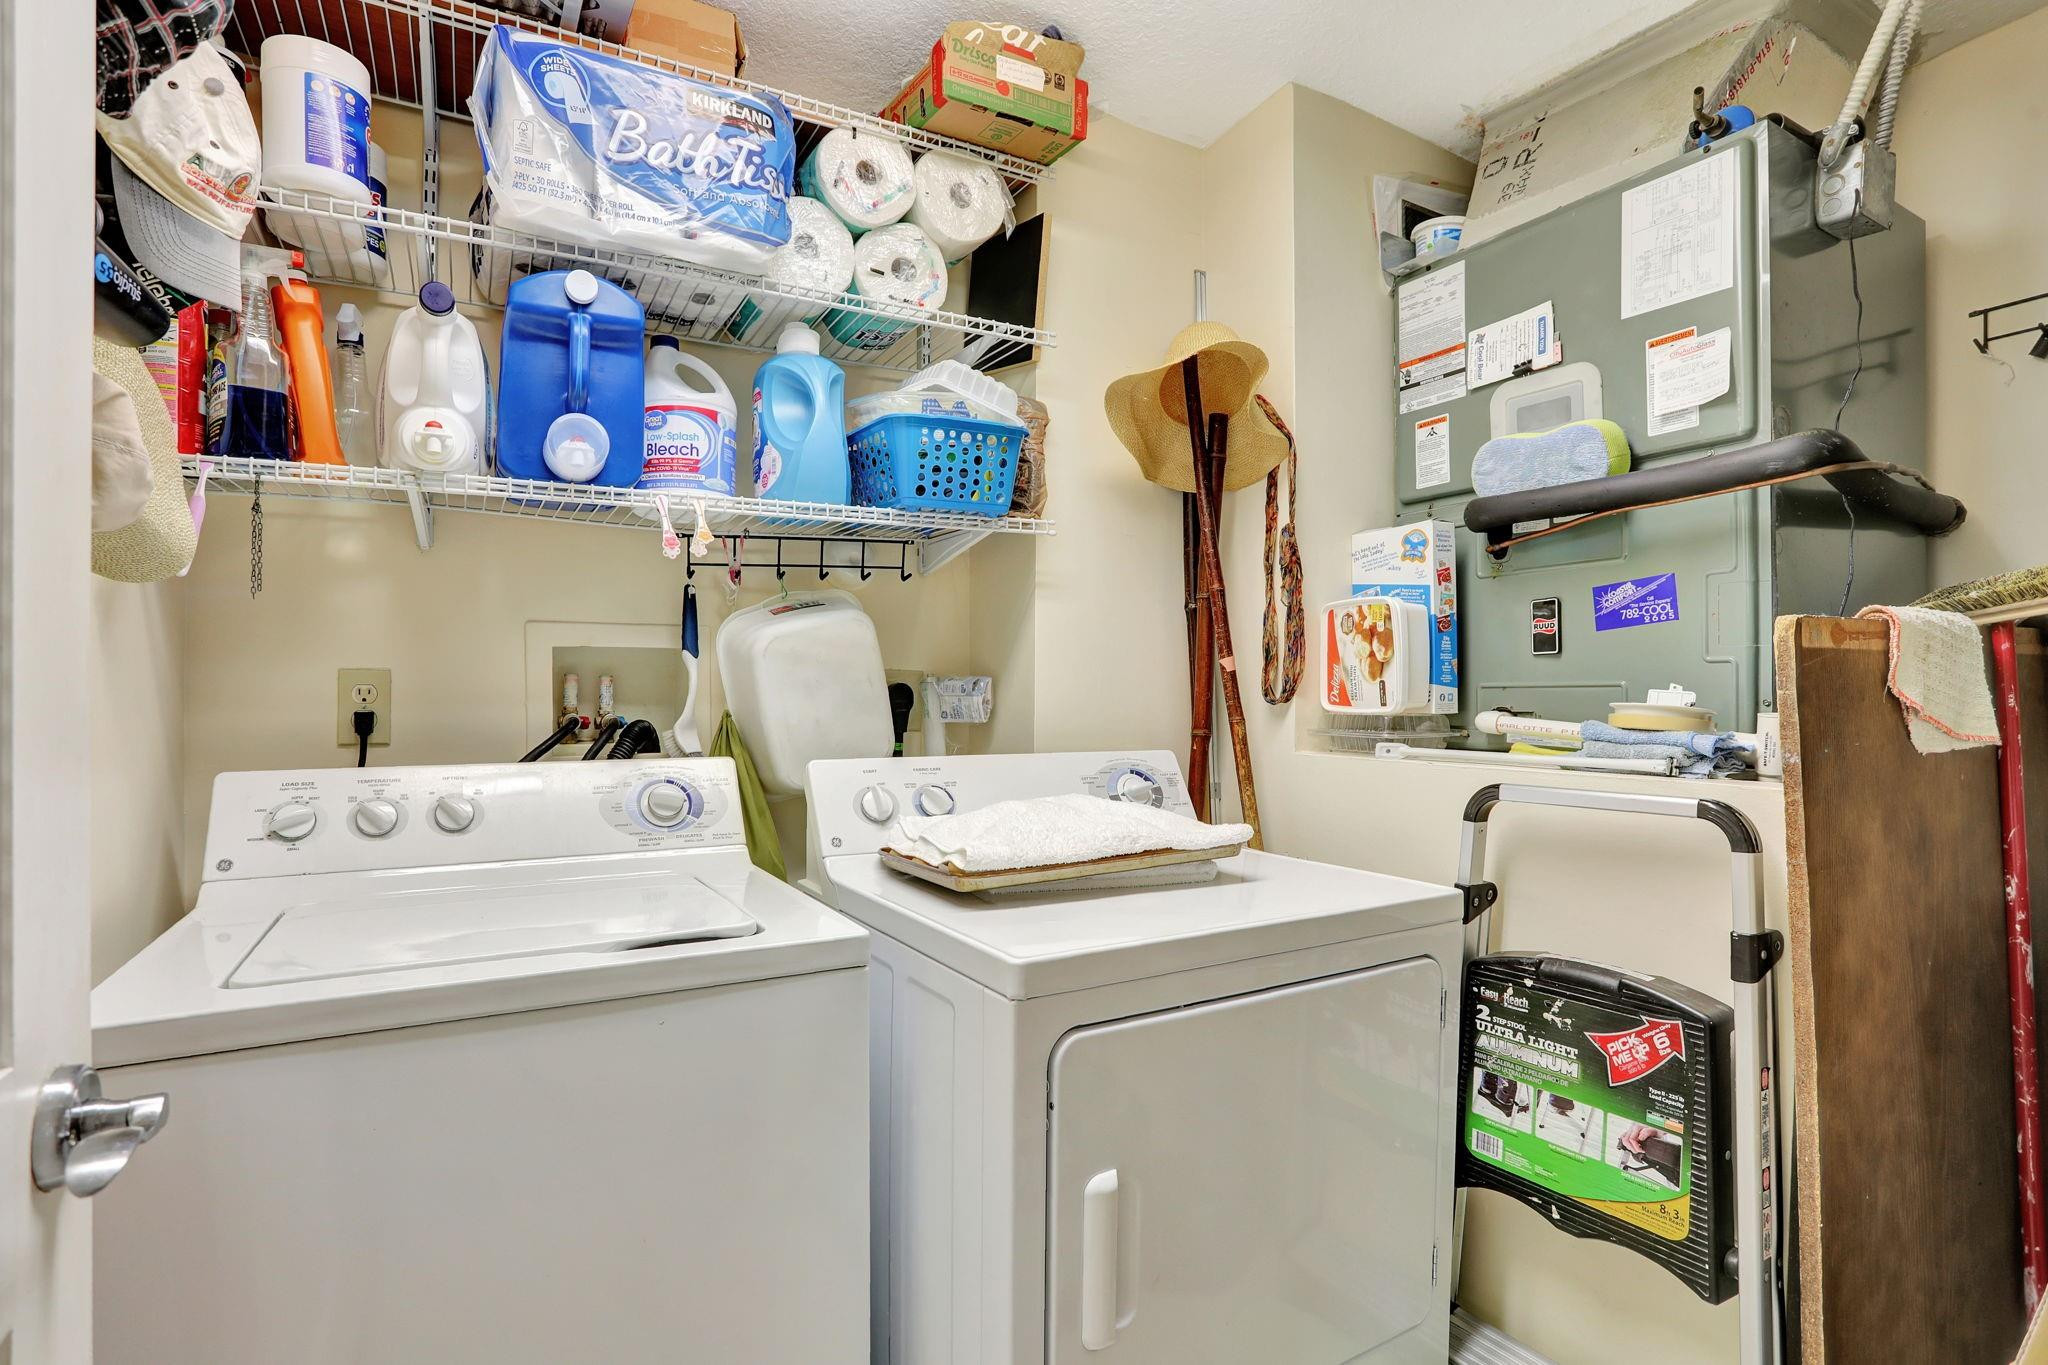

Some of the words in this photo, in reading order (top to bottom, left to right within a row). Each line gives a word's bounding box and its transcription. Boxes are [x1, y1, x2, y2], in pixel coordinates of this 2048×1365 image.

[543, 56, 568, 65] WIDE
[540, 63, 576, 75] SHEETS
[952, 84, 977, 98] Organic
[692, 91, 773, 129] KIRKLAND
[606, 108, 731, 177] Bath
[514, 156, 536, 169] SEPTIC
[536, 161, 552, 172] SAFE
[538, 186, 547, 195] FT
[546, 178, 565, 190] ROLLS
[618, 202, 634, 211] ROLL
[646, 432, 700, 442] Low-Splash
[646, 443, 700, 457] Bleach
[1620, 603, 1674, 620] 782-COOL
[1533, 619, 1556, 632] RUUD
[1329, 663, 1340, 703] Delizza
[1480, 986, 1499, 1001] Easy
[1503, 992, 1529, 1008] Reach
[1475, 1004, 1491, 1021] 2
[1493, 1016, 1507, 1025] STEP
[1507, 1019, 1527, 1032] STOOL
[1475, 1019, 1526, 1044] ULTRA
[1528, 1034, 1579, 1059] LIGHT
[1606, 1033, 1639, 1056] PICK
[1652, 1031, 1671, 1050] 6
[1475, 1033, 1579, 1079] ALUMINUM
[1612, 1049, 1633, 1067] ME
[1649, 1087, 1662, 1096] Type
[1649, 1093, 1662, 1101] Load
[1662, 1097, 1685, 1108] Capacity
[1641, 1206, 1668, 1220] Maximum
[1660, 1204, 1667, 1215] 8
[1673, 1209, 1680, 1220] 3
